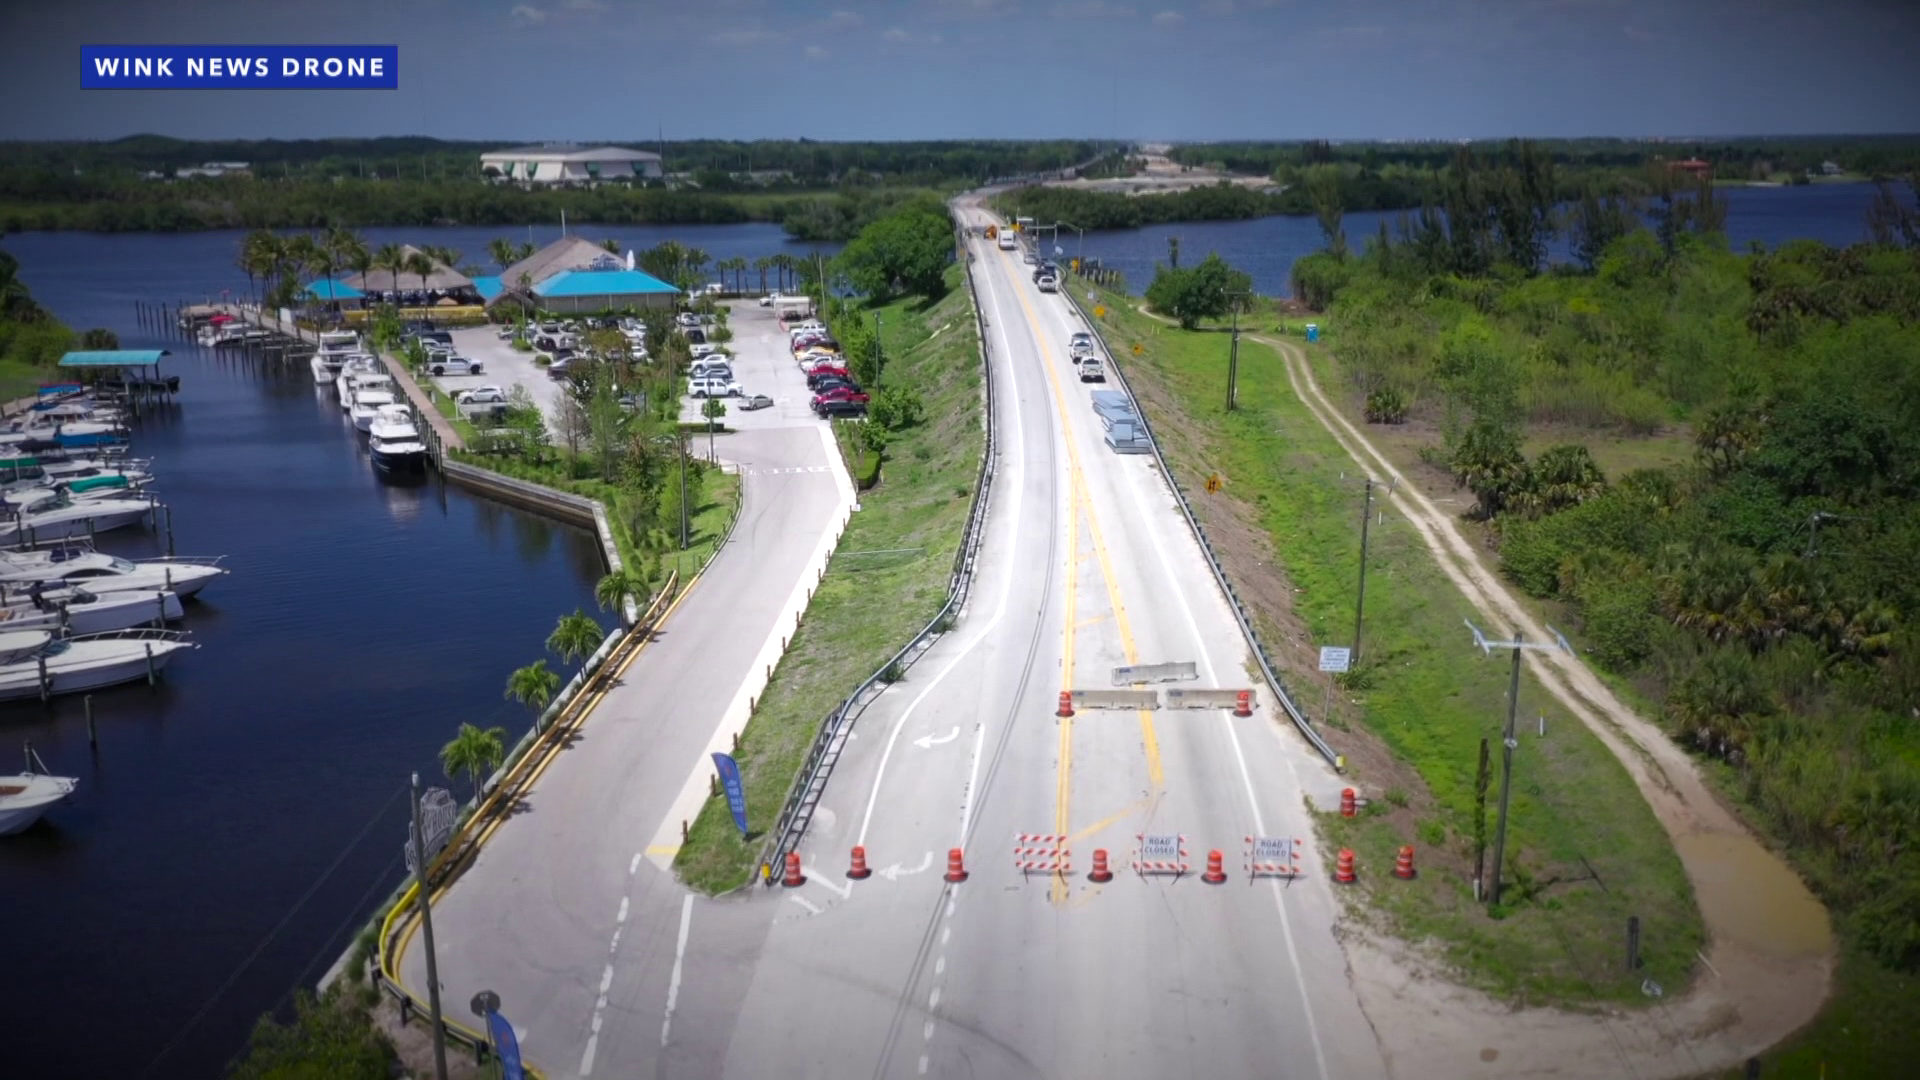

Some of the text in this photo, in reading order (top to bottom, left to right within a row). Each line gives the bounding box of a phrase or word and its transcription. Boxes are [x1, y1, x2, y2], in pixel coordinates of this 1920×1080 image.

[1148, 837, 1171, 845] ROAD
[1260, 839, 1283, 848] ROAD
[1144, 846, 1175, 855] CLOSED
[1255, 848, 1287, 857] CLOSED
